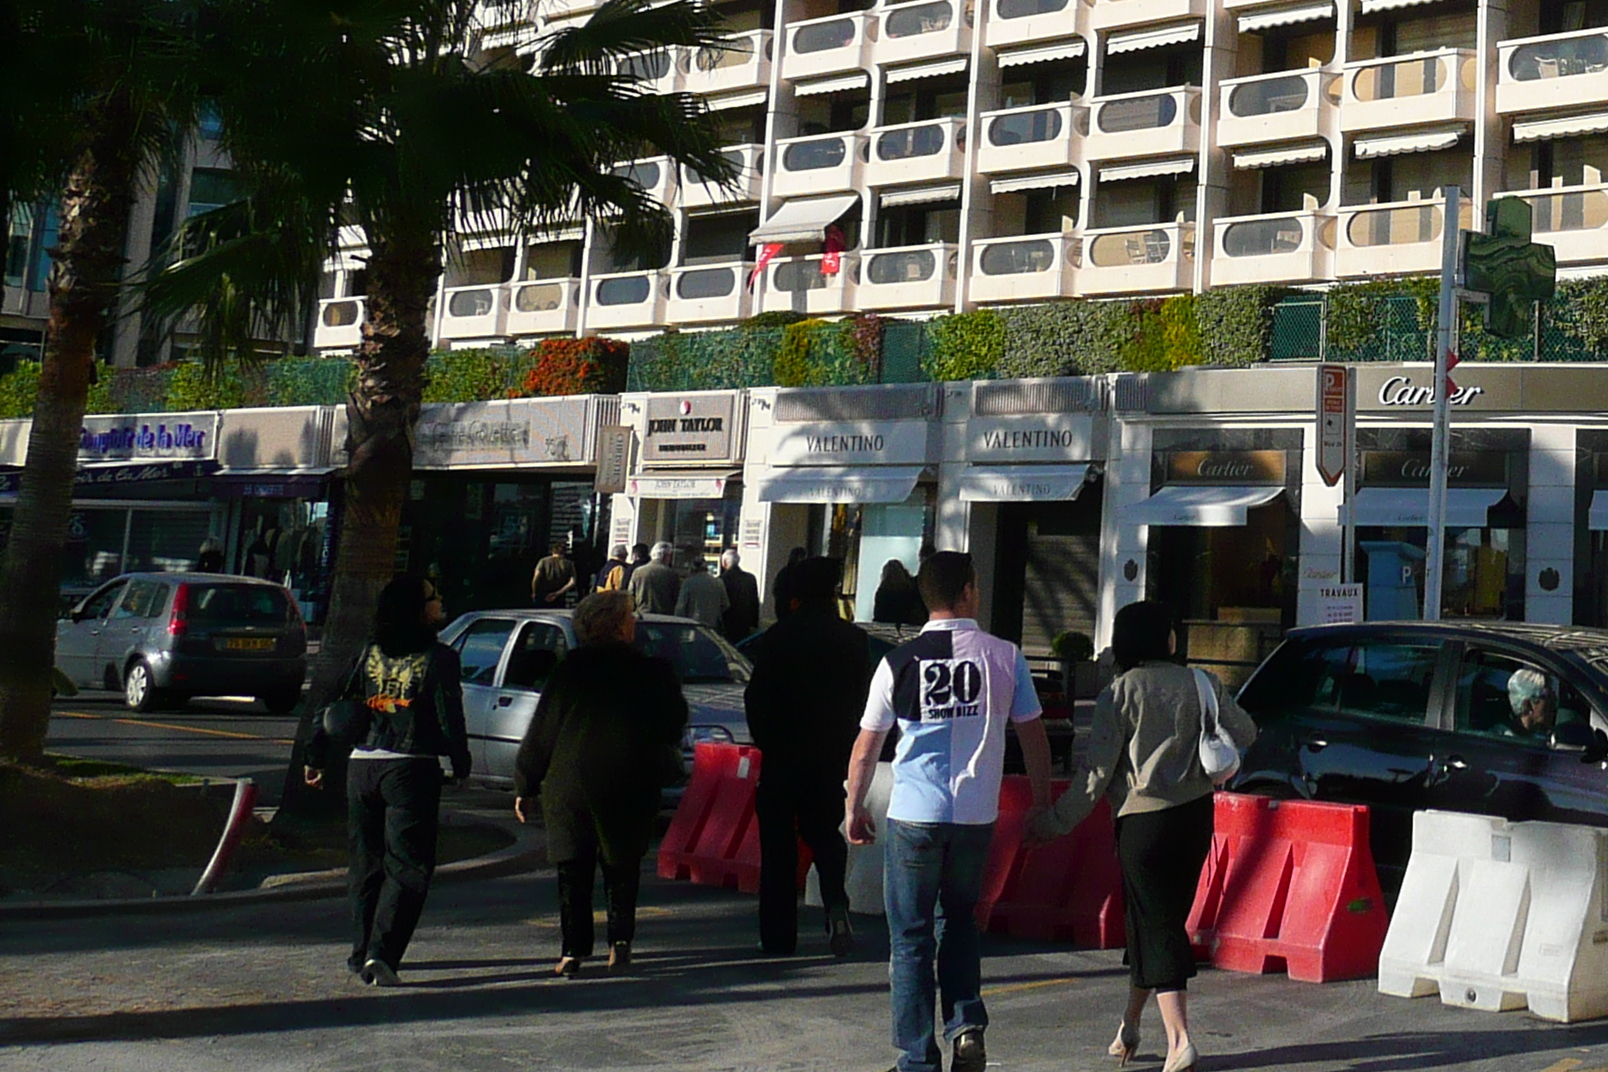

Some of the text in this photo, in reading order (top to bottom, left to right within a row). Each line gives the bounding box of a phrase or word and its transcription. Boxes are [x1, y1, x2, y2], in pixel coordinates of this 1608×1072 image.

[648, 417, 723, 437] JOHN TAYLOR
[806, 435, 884, 452] VALENTINO
[983, 430, 1073, 449] VALENTINO
[1197, 458, 1253, 477] Cartier
[993, 484, 1051, 495] VALENTINO
[1320, 588, 1359, 598] TRAVAUX
[924, 660, 982, 706] 20
[928, 705, 979, 719] SHOW BIZZ
